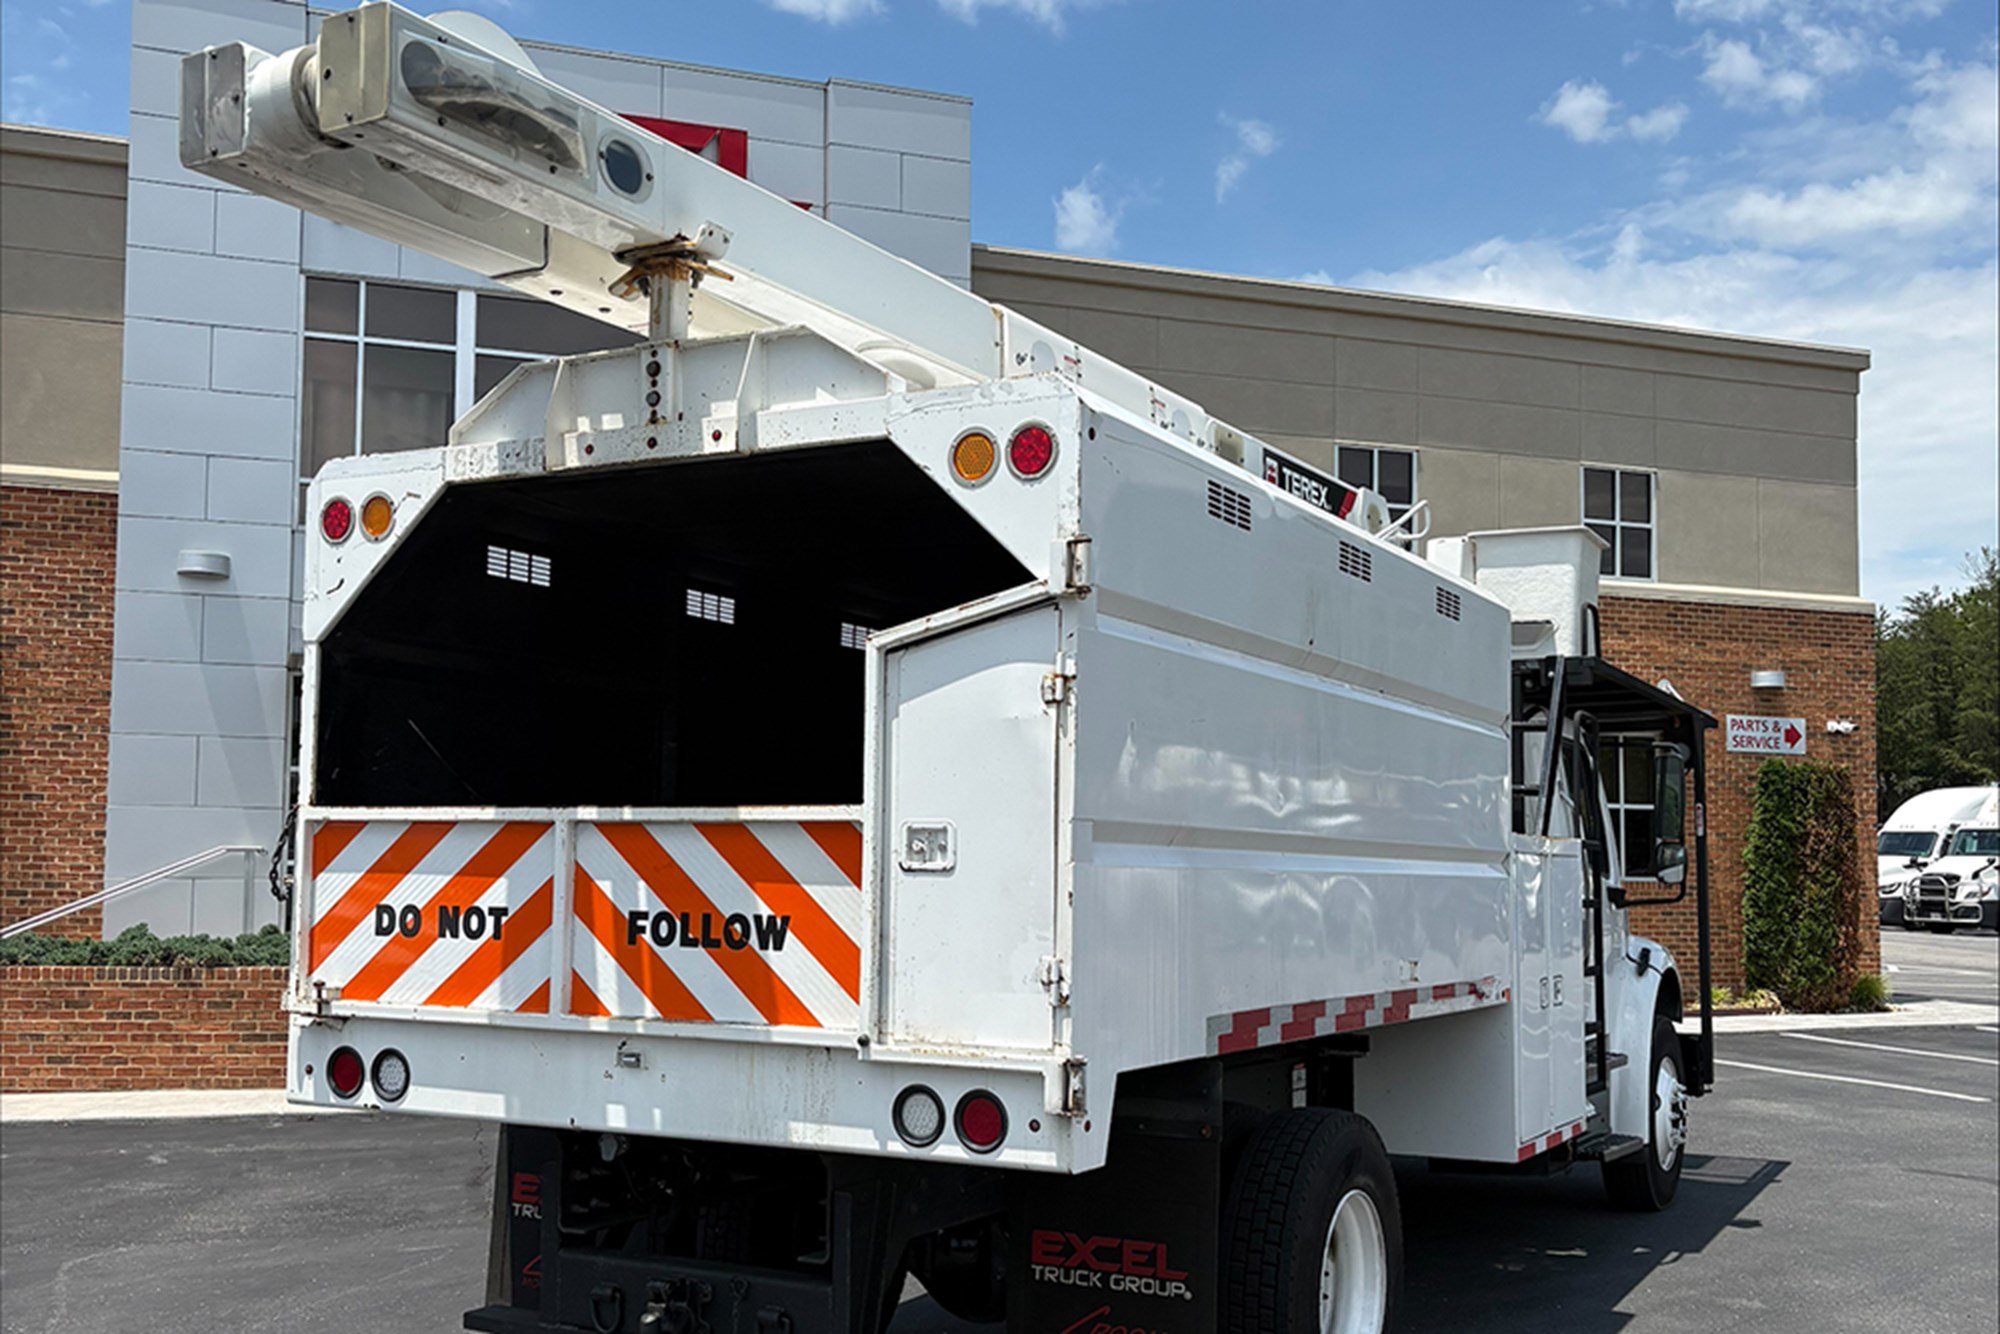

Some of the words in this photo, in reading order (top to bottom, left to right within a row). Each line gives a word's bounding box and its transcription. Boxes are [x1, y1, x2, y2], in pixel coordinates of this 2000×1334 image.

[1282, 467, 1329, 509] TEREX
[1730, 718, 1769, 733] PARTS
[1772, 720, 1781, 733] &
[1732, 734, 1781, 750] SERVICE
[374, 904, 422, 939] DO
[437, 905, 509, 940] NOT
[627, 910, 791, 951] FOLLOW
[1031, 1229, 1189, 1281] EXCEL
[1031, 1264, 1102, 1288] TRUCK
